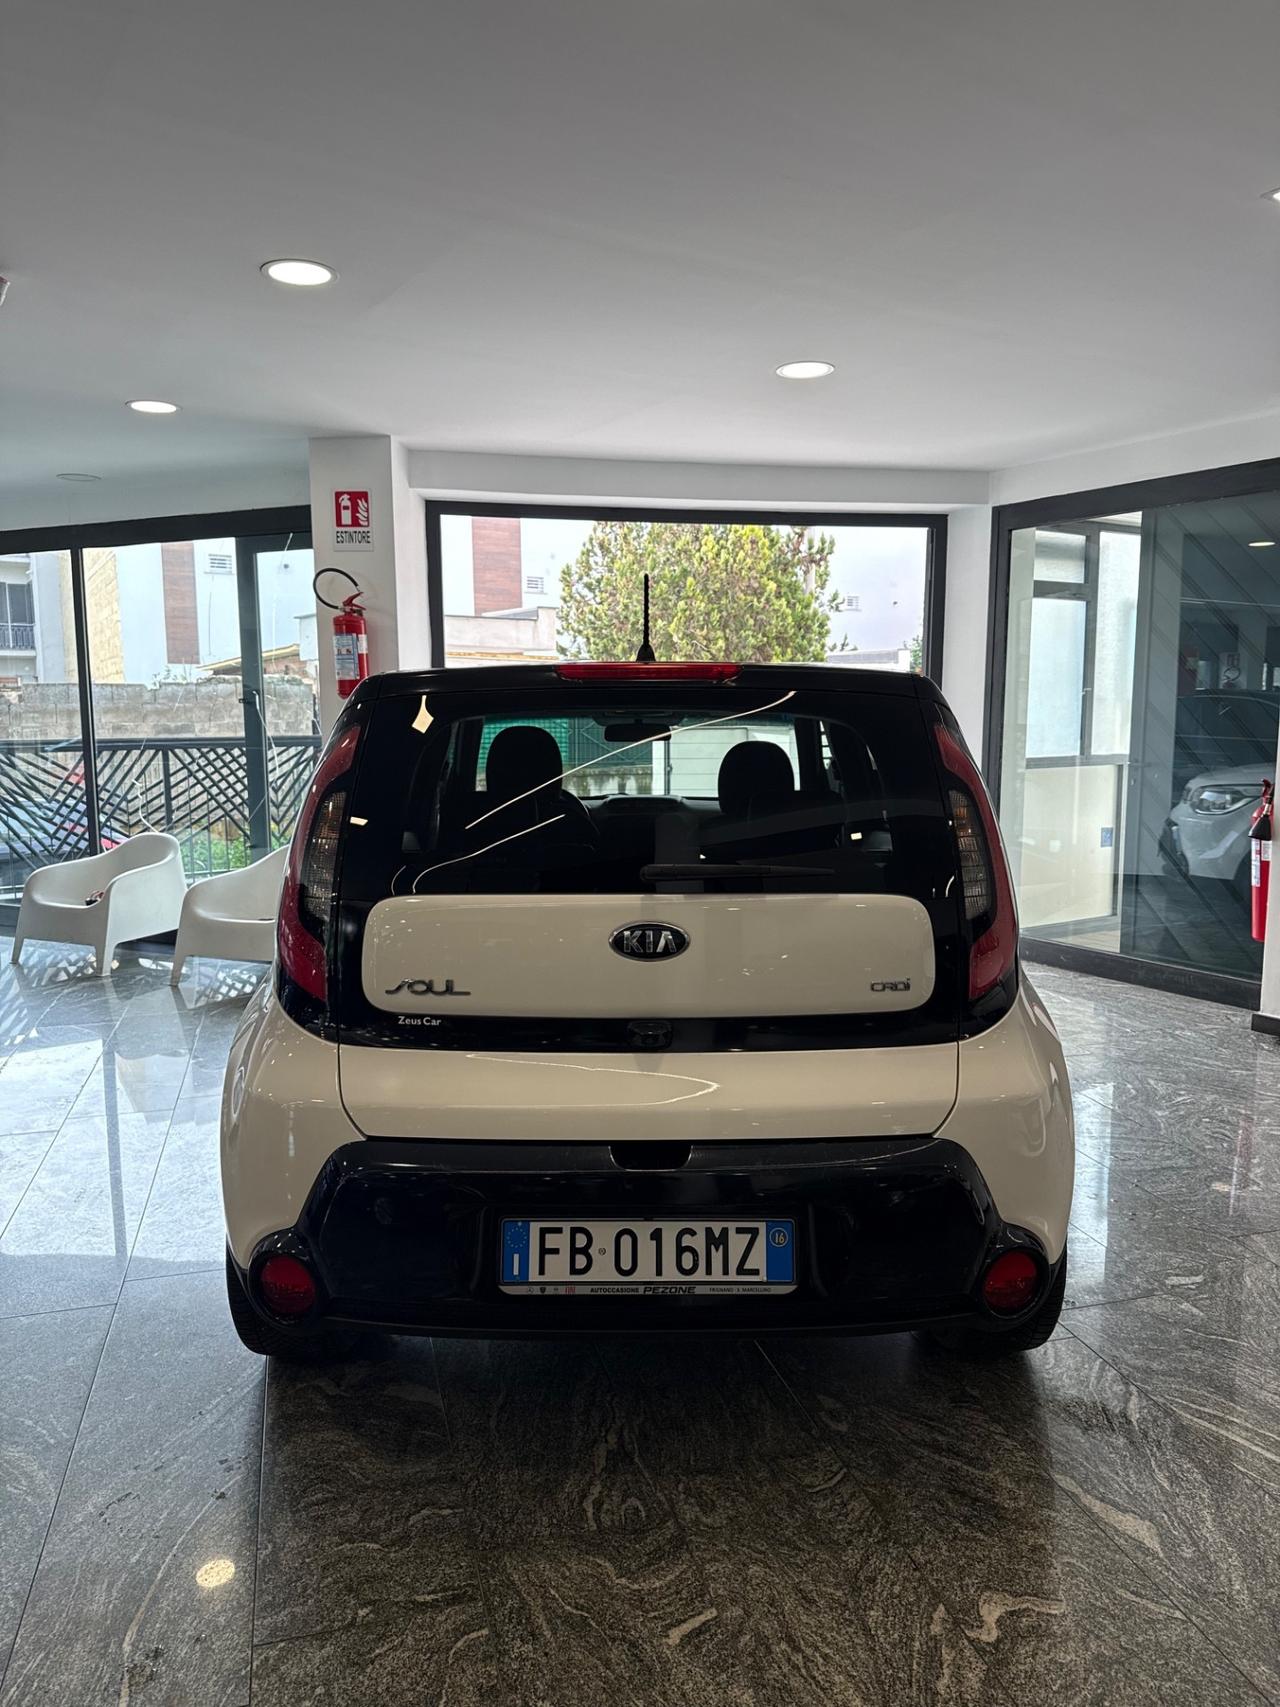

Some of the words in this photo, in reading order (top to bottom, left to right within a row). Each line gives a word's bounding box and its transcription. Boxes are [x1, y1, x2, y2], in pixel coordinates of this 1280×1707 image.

[335, 530, 371, 544] ESTINTORE
[623, 929, 678, 953] KIA
[385, 978, 471, 996] SOUL
[398, 1015, 422, 1026] Zeus
[423, 1016, 442, 1026] Car
[643, 1286, 697, 1294] PEZONE
